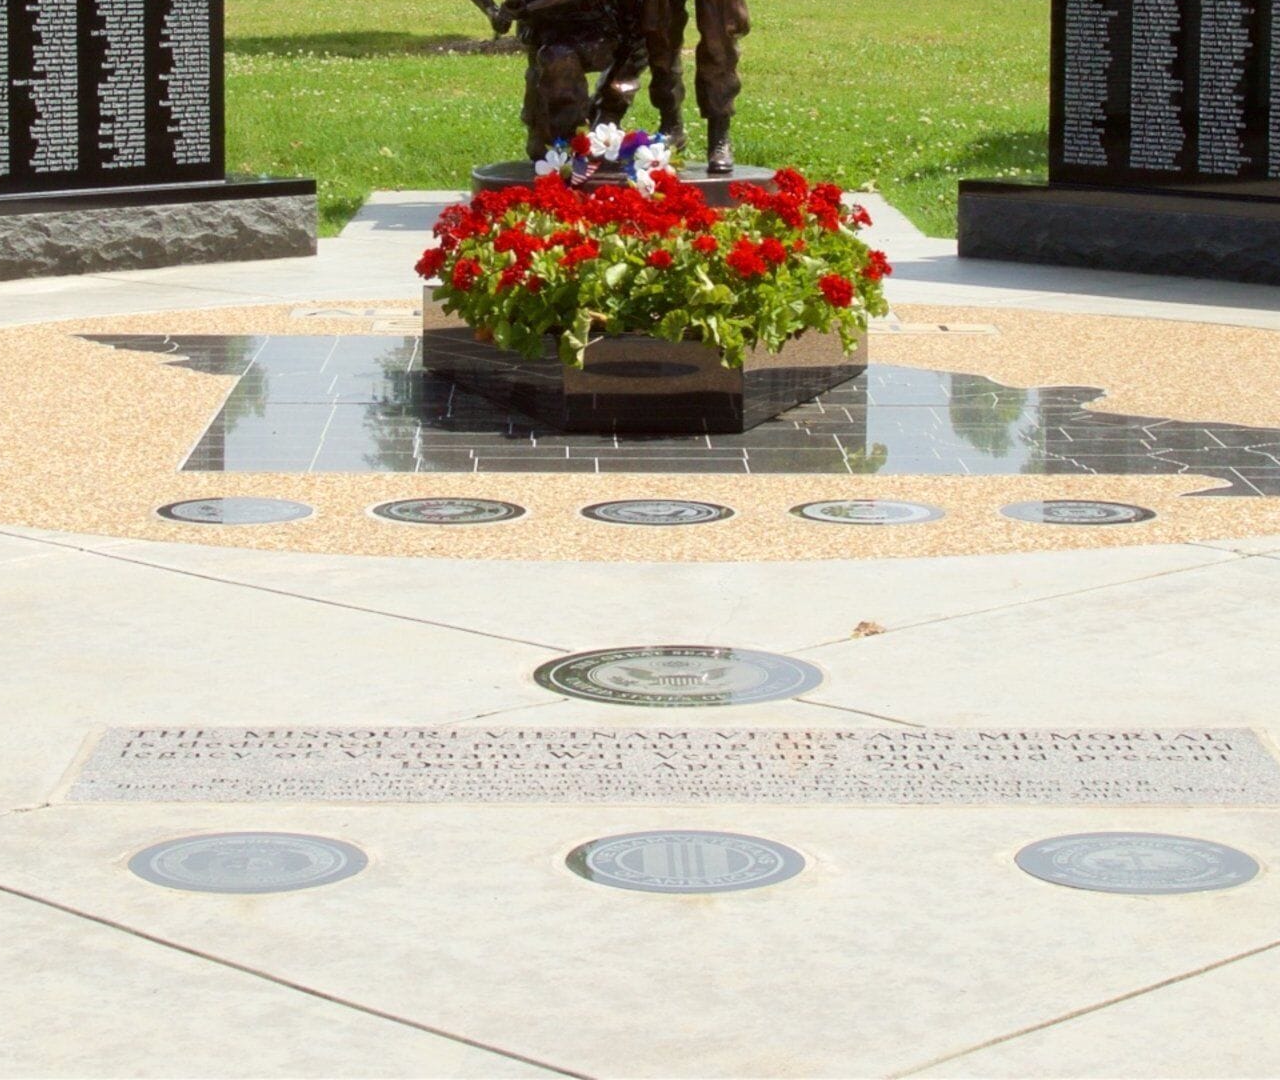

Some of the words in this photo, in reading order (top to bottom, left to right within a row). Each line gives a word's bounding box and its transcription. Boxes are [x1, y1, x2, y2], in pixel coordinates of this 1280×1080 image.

[244, 731, 458, 739] MISSOURI
[486, 731, 689, 740] VIETNAM
[715, 732, 956, 740] VETERANS
[978, 732, 1226, 741] MEMORIAL
[179, 740, 384, 748] dedicated
[473, 742, 748, 751] perpetuating
[863, 743, 1134, 751] appreciation
[120, 750, 252, 759] legacy
[344, 751, 521, 759] Vietnam
[654, 752, 838, 760] Veterans
[865, 753, 946, 761] past
[400, 761, 623, 770] Dedicated
[652, 762, 763, 771] April
